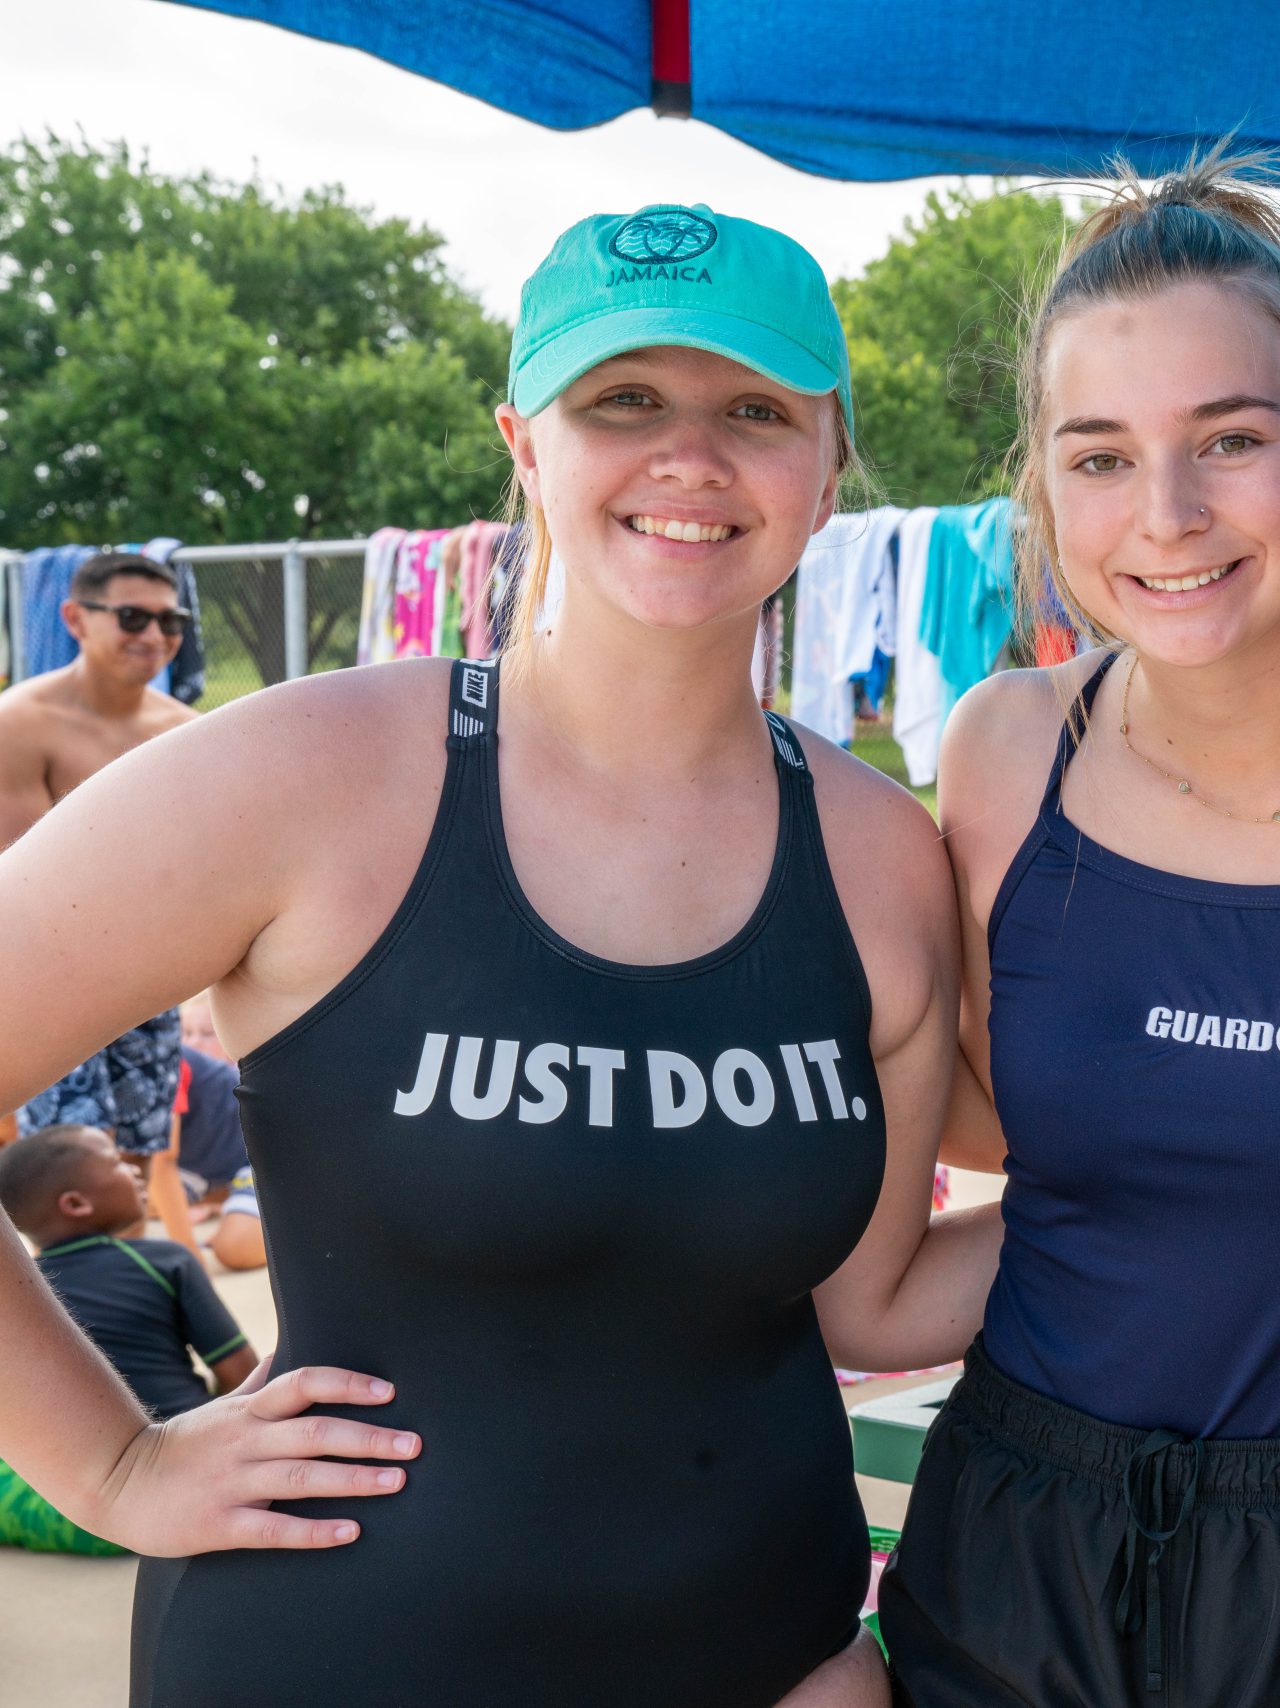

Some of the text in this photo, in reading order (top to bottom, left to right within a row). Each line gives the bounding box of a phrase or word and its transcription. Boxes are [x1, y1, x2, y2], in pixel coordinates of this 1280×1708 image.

[605, 266, 713, 287] JAMAICA
[1145, 1005, 1275, 1053] GUARD
[393, 1032, 867, 1128] JUST DO IT.
